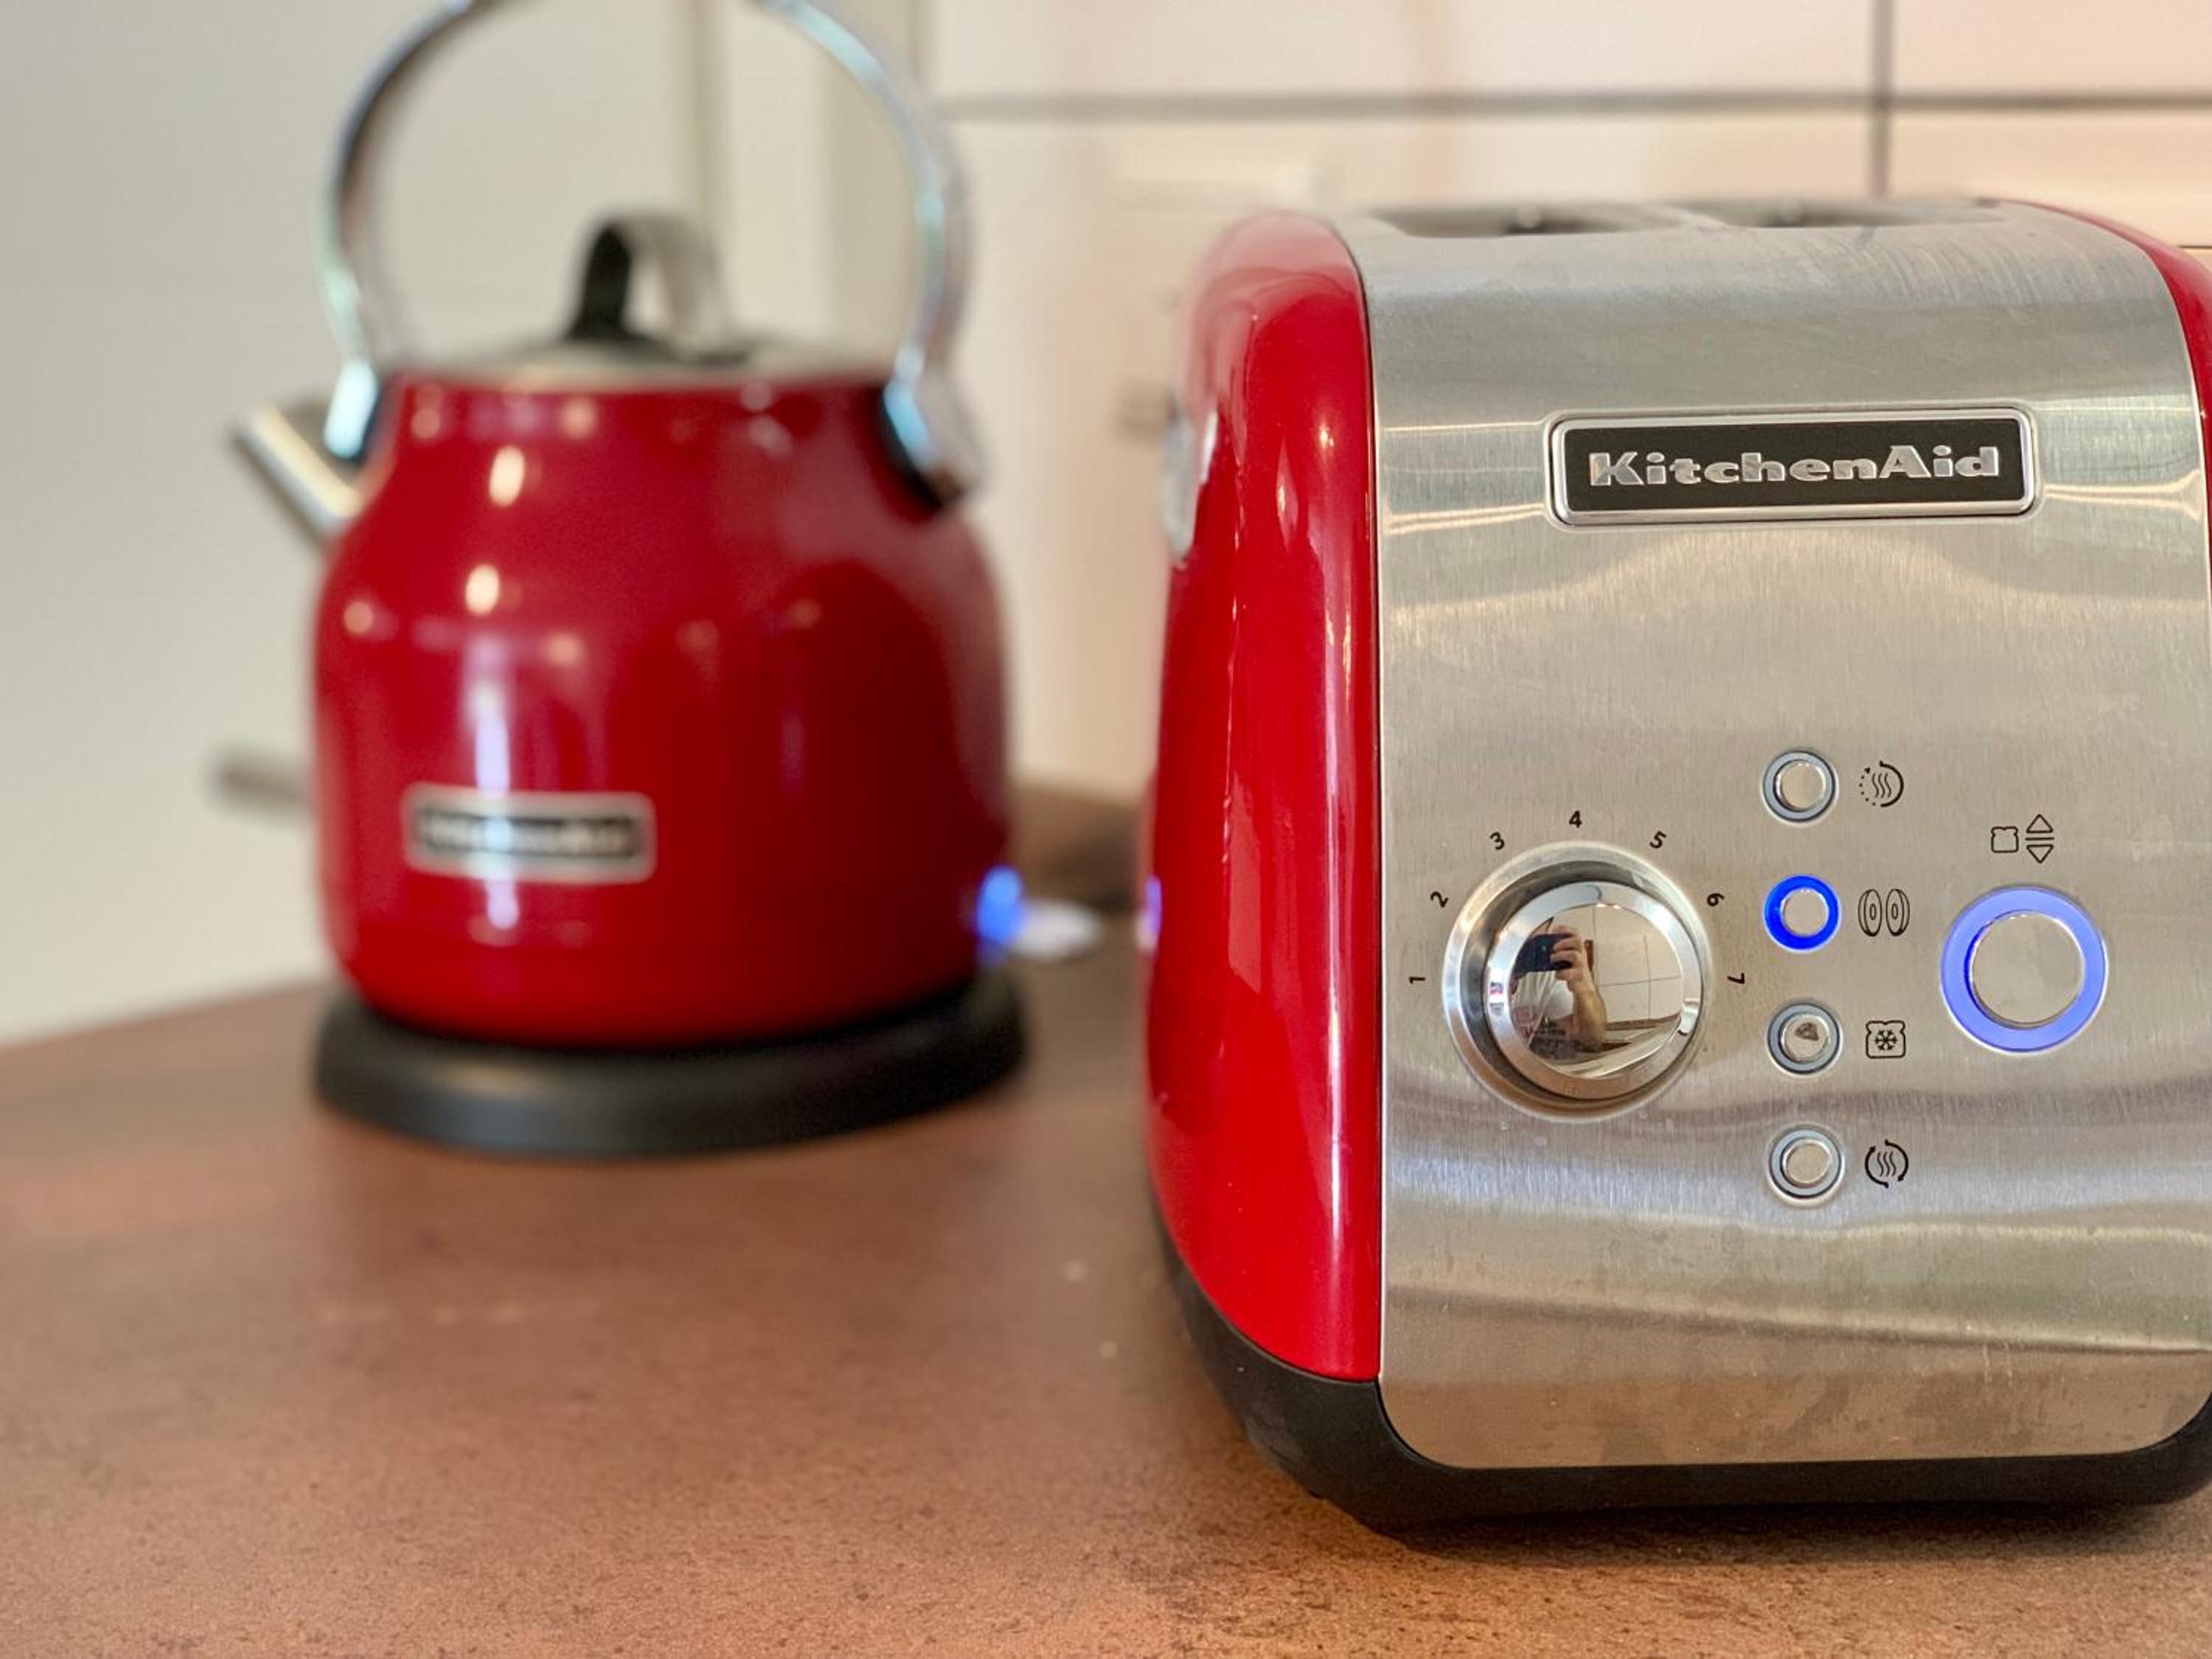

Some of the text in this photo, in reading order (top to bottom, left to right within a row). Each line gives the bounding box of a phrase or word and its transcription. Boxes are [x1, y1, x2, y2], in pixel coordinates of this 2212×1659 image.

[1589, 445, 1999, 486] KitchenAid
[1568, 810, 1582, 828] 4
[1489, 832, 1505, 850] 3
[1649, 831, 1666, 849] 5
[1430, 891, 1449, 908] 2
[1706, 892, 1725, 907] 6
[1408, 975, 1426, 984] 1
[1727, 973, 1745, 984] 7
